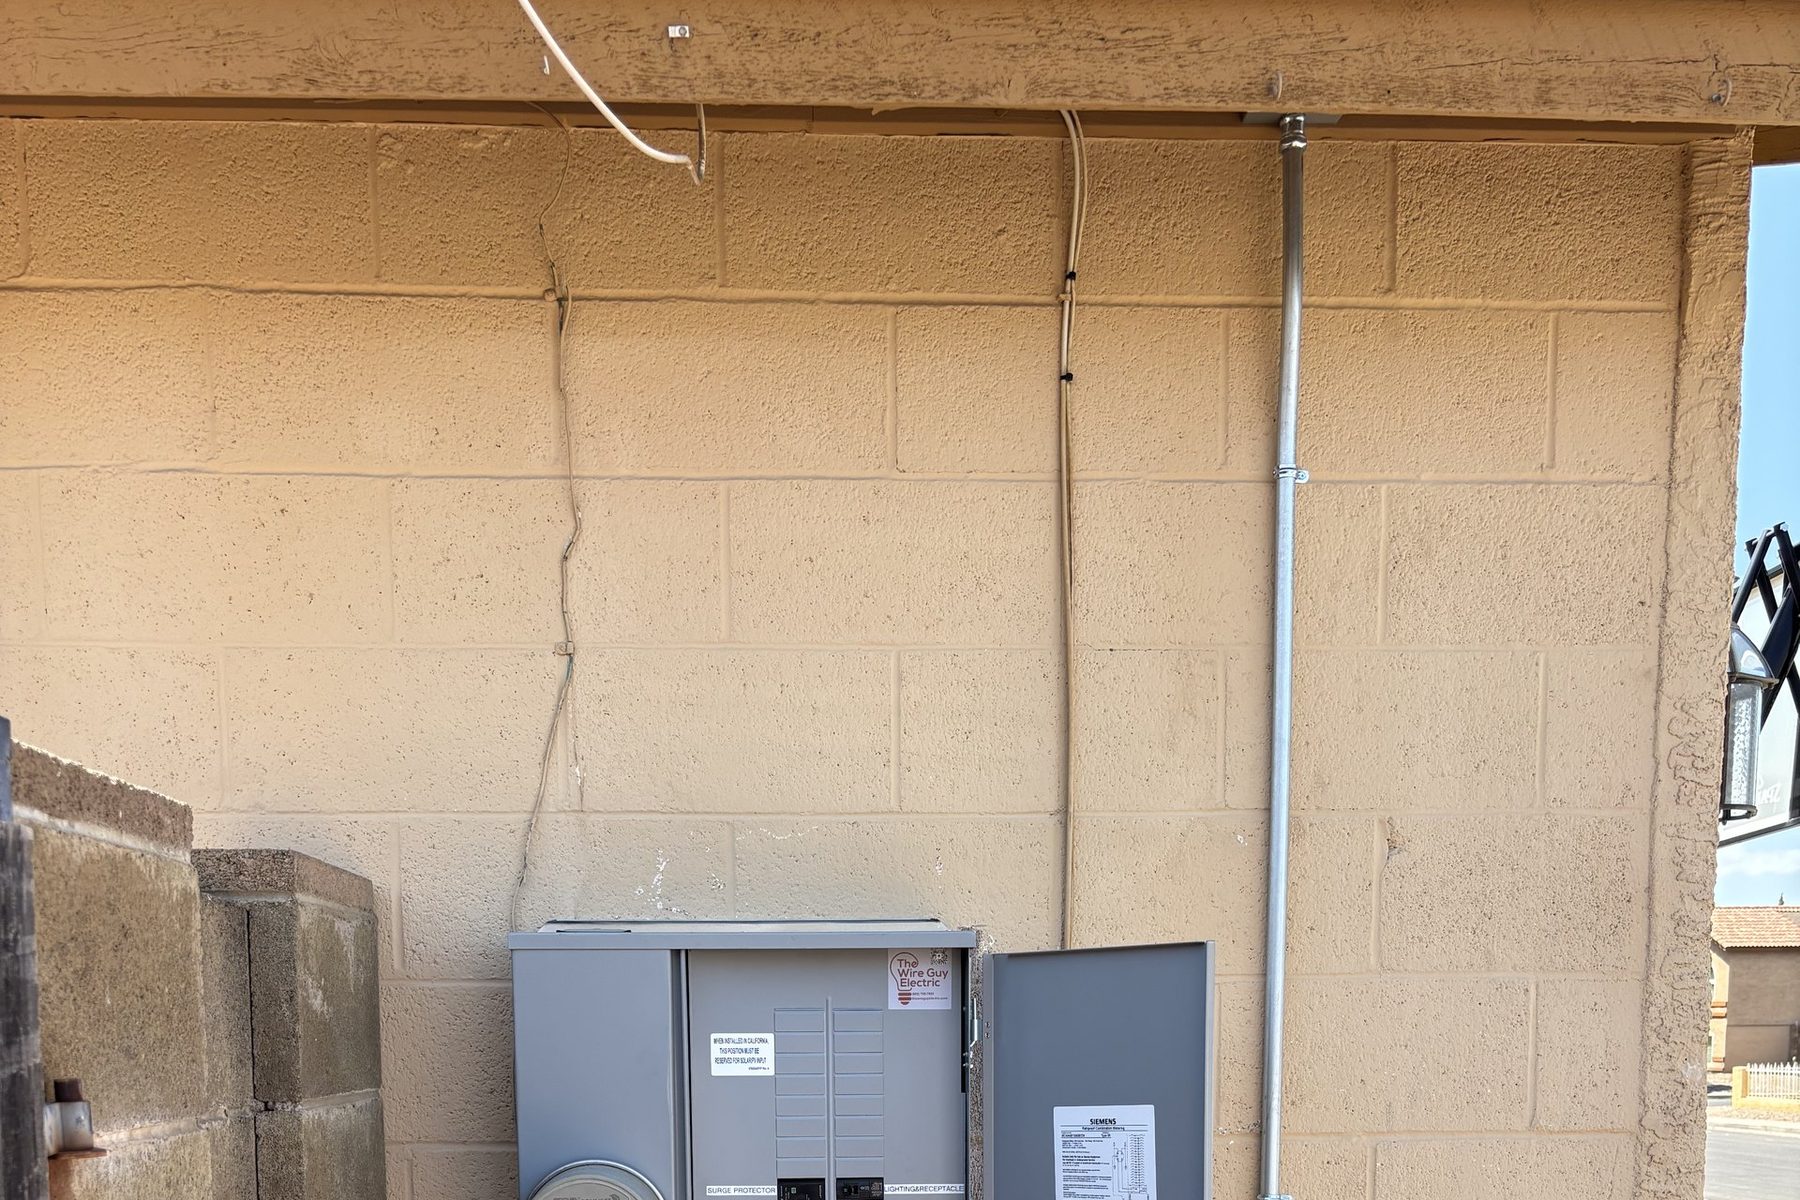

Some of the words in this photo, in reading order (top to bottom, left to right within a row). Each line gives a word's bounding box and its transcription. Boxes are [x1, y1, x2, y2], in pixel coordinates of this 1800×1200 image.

[896, 959, 918, 968] The
[898, 968, 924, 978] Wire
[926, 968, 948, 980] Guy
[900, 978, 940, 987] Electric
